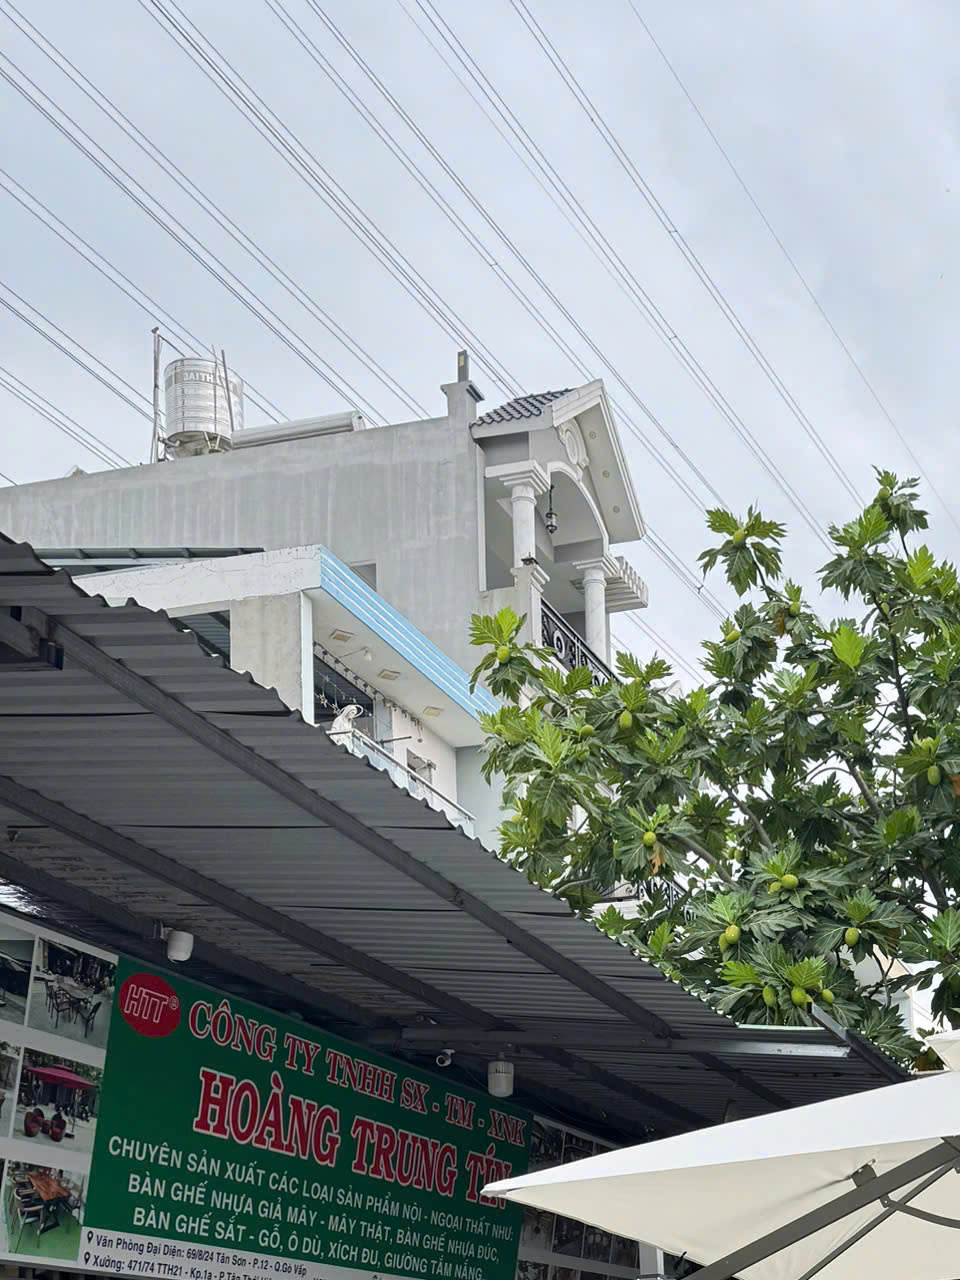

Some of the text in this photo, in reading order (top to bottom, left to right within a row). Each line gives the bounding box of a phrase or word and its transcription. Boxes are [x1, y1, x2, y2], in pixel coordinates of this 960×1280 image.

[189, 999, 277, 1062] CÔNG
[284, 1032, 321, 1076] TY
[326, 1048, 397, 1103] TNHH
[400, 1077, 430, 1115] SX
[445, 1092, 475, 1129] TM
[488, 1108, 527, 1147] XNK
[193, 1067, 512, 1209] HOÀNG TRUNG TÍN
[108, 1136, 182, 1168] CHUYÊN
[186, 1149, 220, 1177] SẢN
[224, 1161, 265, 1187] XUẤT
[269, 1171, 299, 1194] CÁC
[302, 1180, 334, 1204] LOẠI
[336, 1184, 362, 1210] SẢN
[365, 1192, 399, 1217] PHẨM
[402, 1203, 422, 1224] NỘI
[430, 1210, 462, 1232] NGOẠI
[465, 1215, 490, 1236] THẤT
[128, 1171, 166, 1198] BÀN
[170, 1180, 208, 1206] GHẾ
[211, 1190, 253, 1216] NHỰA
[258, 1197, 282, 1221] GIẢ
[287, 1205, 318, 1227] MÂY
[328, 1213, 358, 1236] MÂY
[360, 1220, 393, 1244] THẬT,
[396, 1226, 420, 1248] BÀN
[422, 1231, 446, 1253] GHẾ
[448, 1238, 475, 1258] NHỰA
[477, 1242, 500, 1264] ĐÚC,
[96, 1235, 113, 1249] Văn
[115, 1237, 144, 1255] Phòng
[146, 1242, 161, 1257] Đại
[163, 1245, 184, 1260] Diện:
[186, 1247, 214, 1262] 69/8/24
[215, 1251, 230, 1265] Tân
[231, 1254, 247, 1268] Sơn
[252, 1256, 268, 1270] P.12
[274, 1261, 292, 1275] Q.Gò
[293, 1263, 307, 1278] Vấp
[127, 1259, 155, 1273] 471/74
[157, 1263, 182, 1277] TTH21
[133, 1204, 170, 1231] BÀN
[175, 1211, 213, 1237] GHẾ
[214, 1215, 246, 1242] SẮT
[258, 1223, 284, 1252] GỖ,
[288, 1230, 299, 1252] Ô
[302, 1234, 324, 1260] DÙ,
[328, 1238, 358, 1262] XÍCH
[361, 1247, 381, 1268] ĐU,
[384, 1251, 428, 1274] GIƯỜNG
[431, 1256, 451, 1277] TẮM
